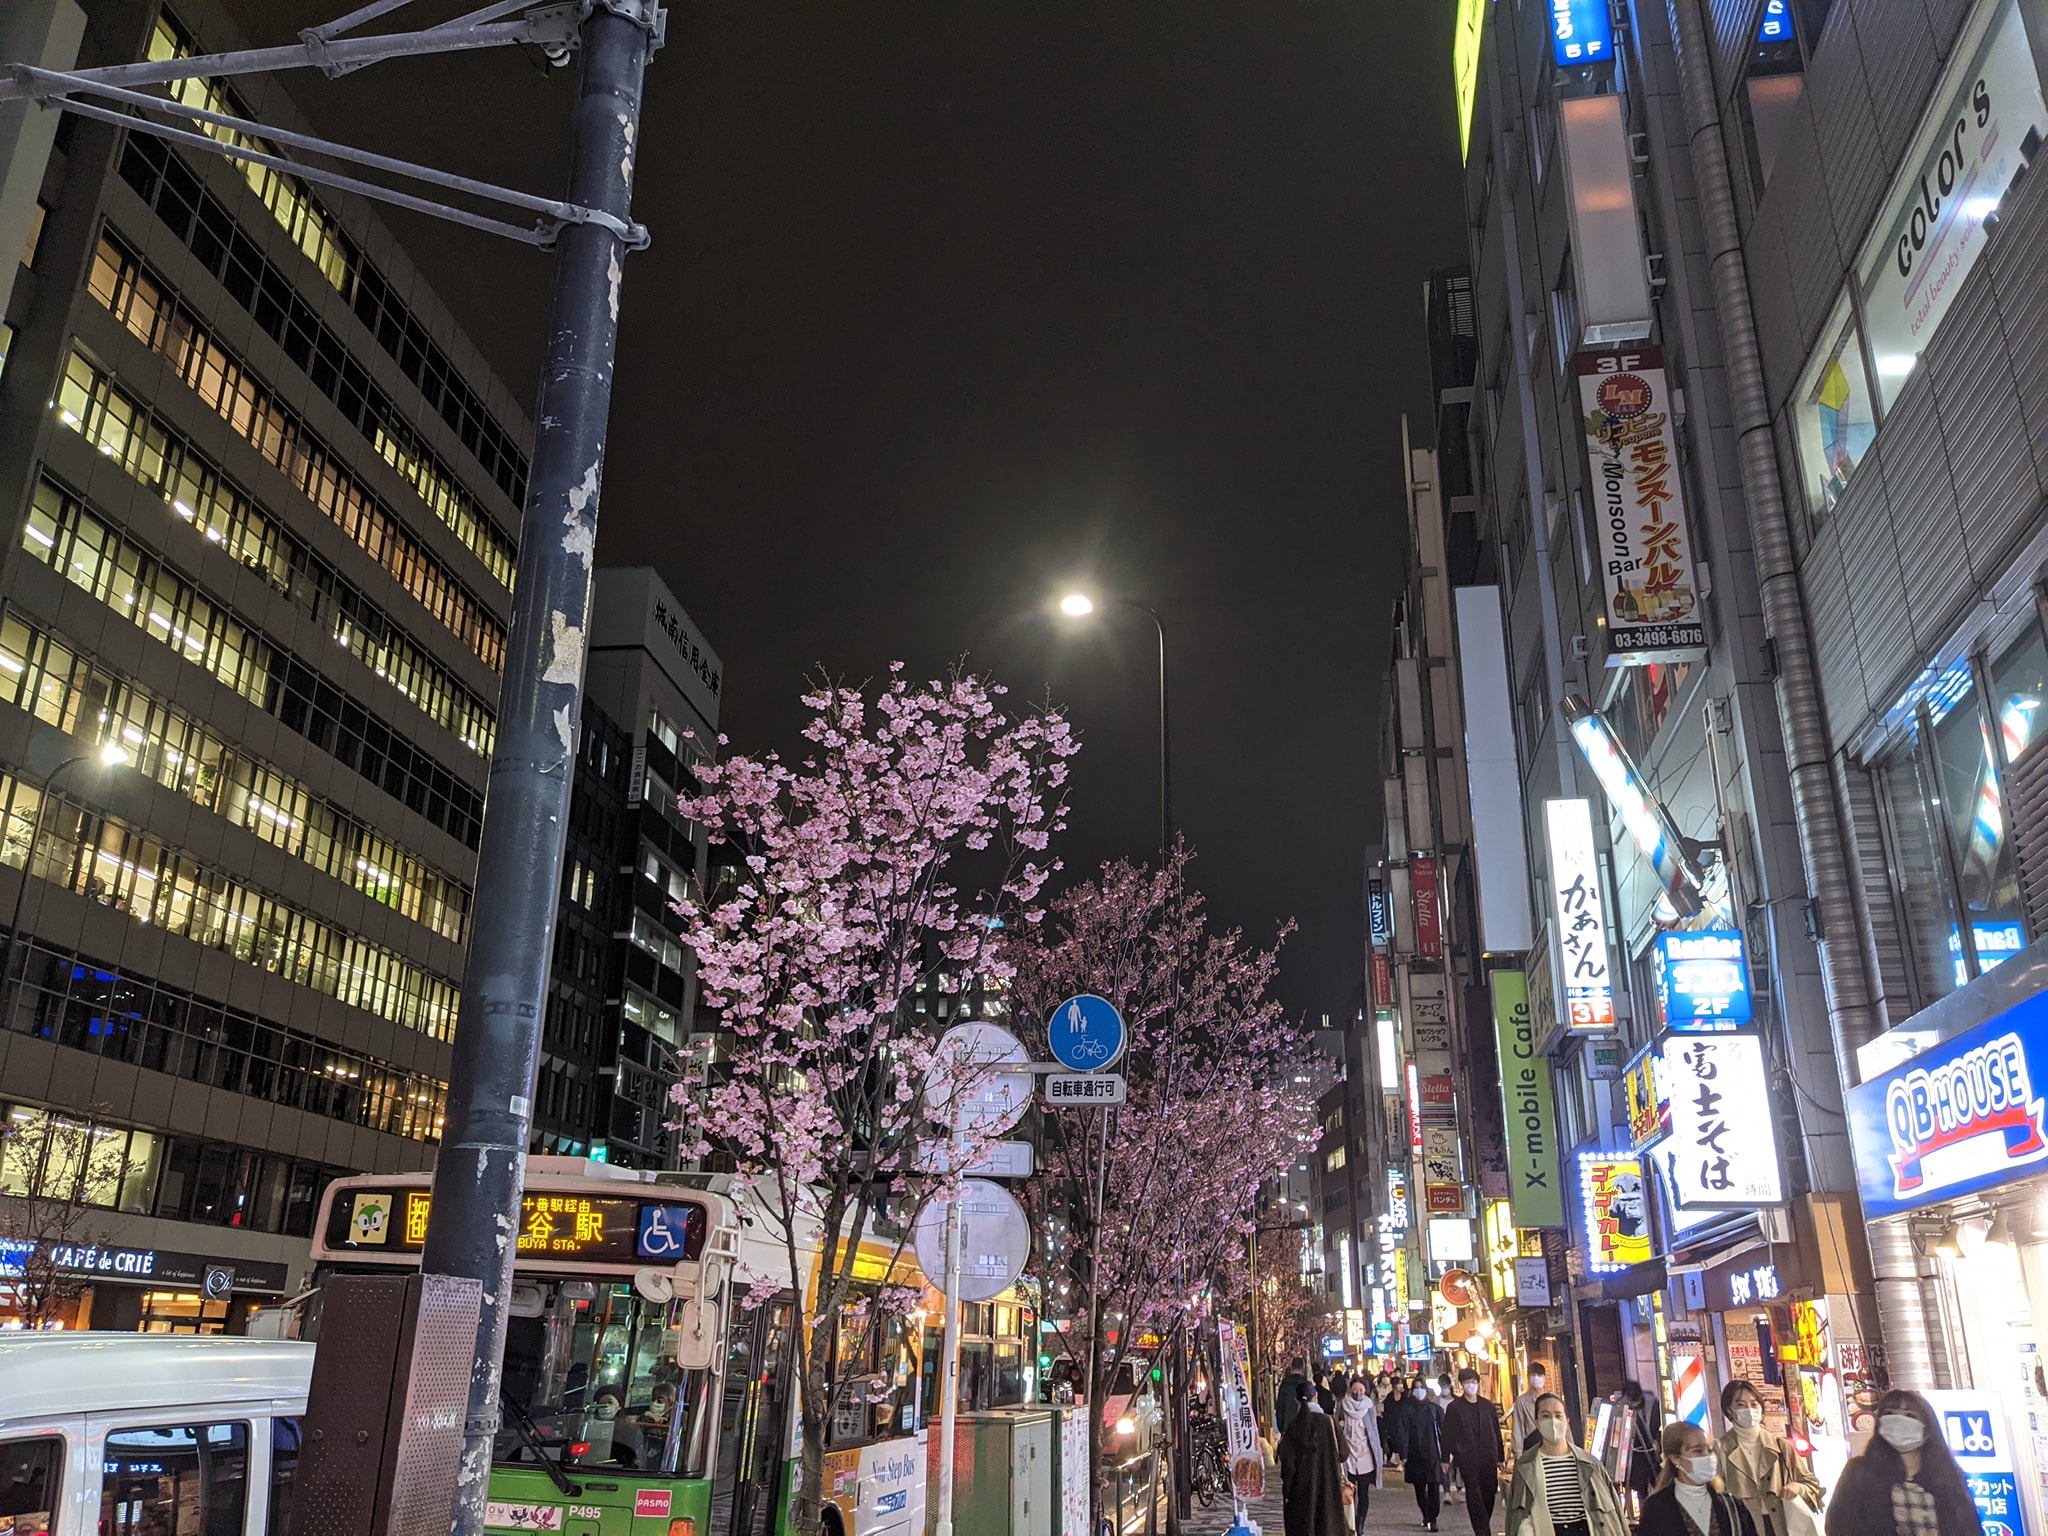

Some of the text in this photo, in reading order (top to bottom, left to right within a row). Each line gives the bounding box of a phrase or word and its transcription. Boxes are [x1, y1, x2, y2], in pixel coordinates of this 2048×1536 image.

[1930, 245, 1961, 299] beauty
[1596, 354, 1641, 373] 3F
[1595, 412, 1667, 444] リコピン
[1601, 462, 1630, 558] Monsoon
[1630, 439, 1685, 588] モンスーンバル
[1607, 555, 1644, 577] Bar
[1614, 628, 1703, 648] 03-3498-6876
[1416, 889, 1434, 926] Stella
[1573, 1001, 1614, 1023] 3F
[1692, 997, 1730, 1015] 2F
[1509, 1002, 1533, 1057] Cafe
[1052, 1080, 1116, 1097] 自転車通行可
[1421, 1081, 1450, 1093] Stella
[1889, 1040, 2026, 1150] QB HOUSE
[1683, 1041, 1739, 1191] 富士そば
[522, 1198, 590, 1213] 十番駅経由
[1591, 1163, 1621, 1263] ゴーゴーカレー
[553, 1239, 582, 1251] STA.
[99, 1254, 112, 1270] de
[115, 1252, 153, 1274] CRIÉ
[568, 1504, 602, 1519] P495
[637, 1498, 669, 1508] PASMO
